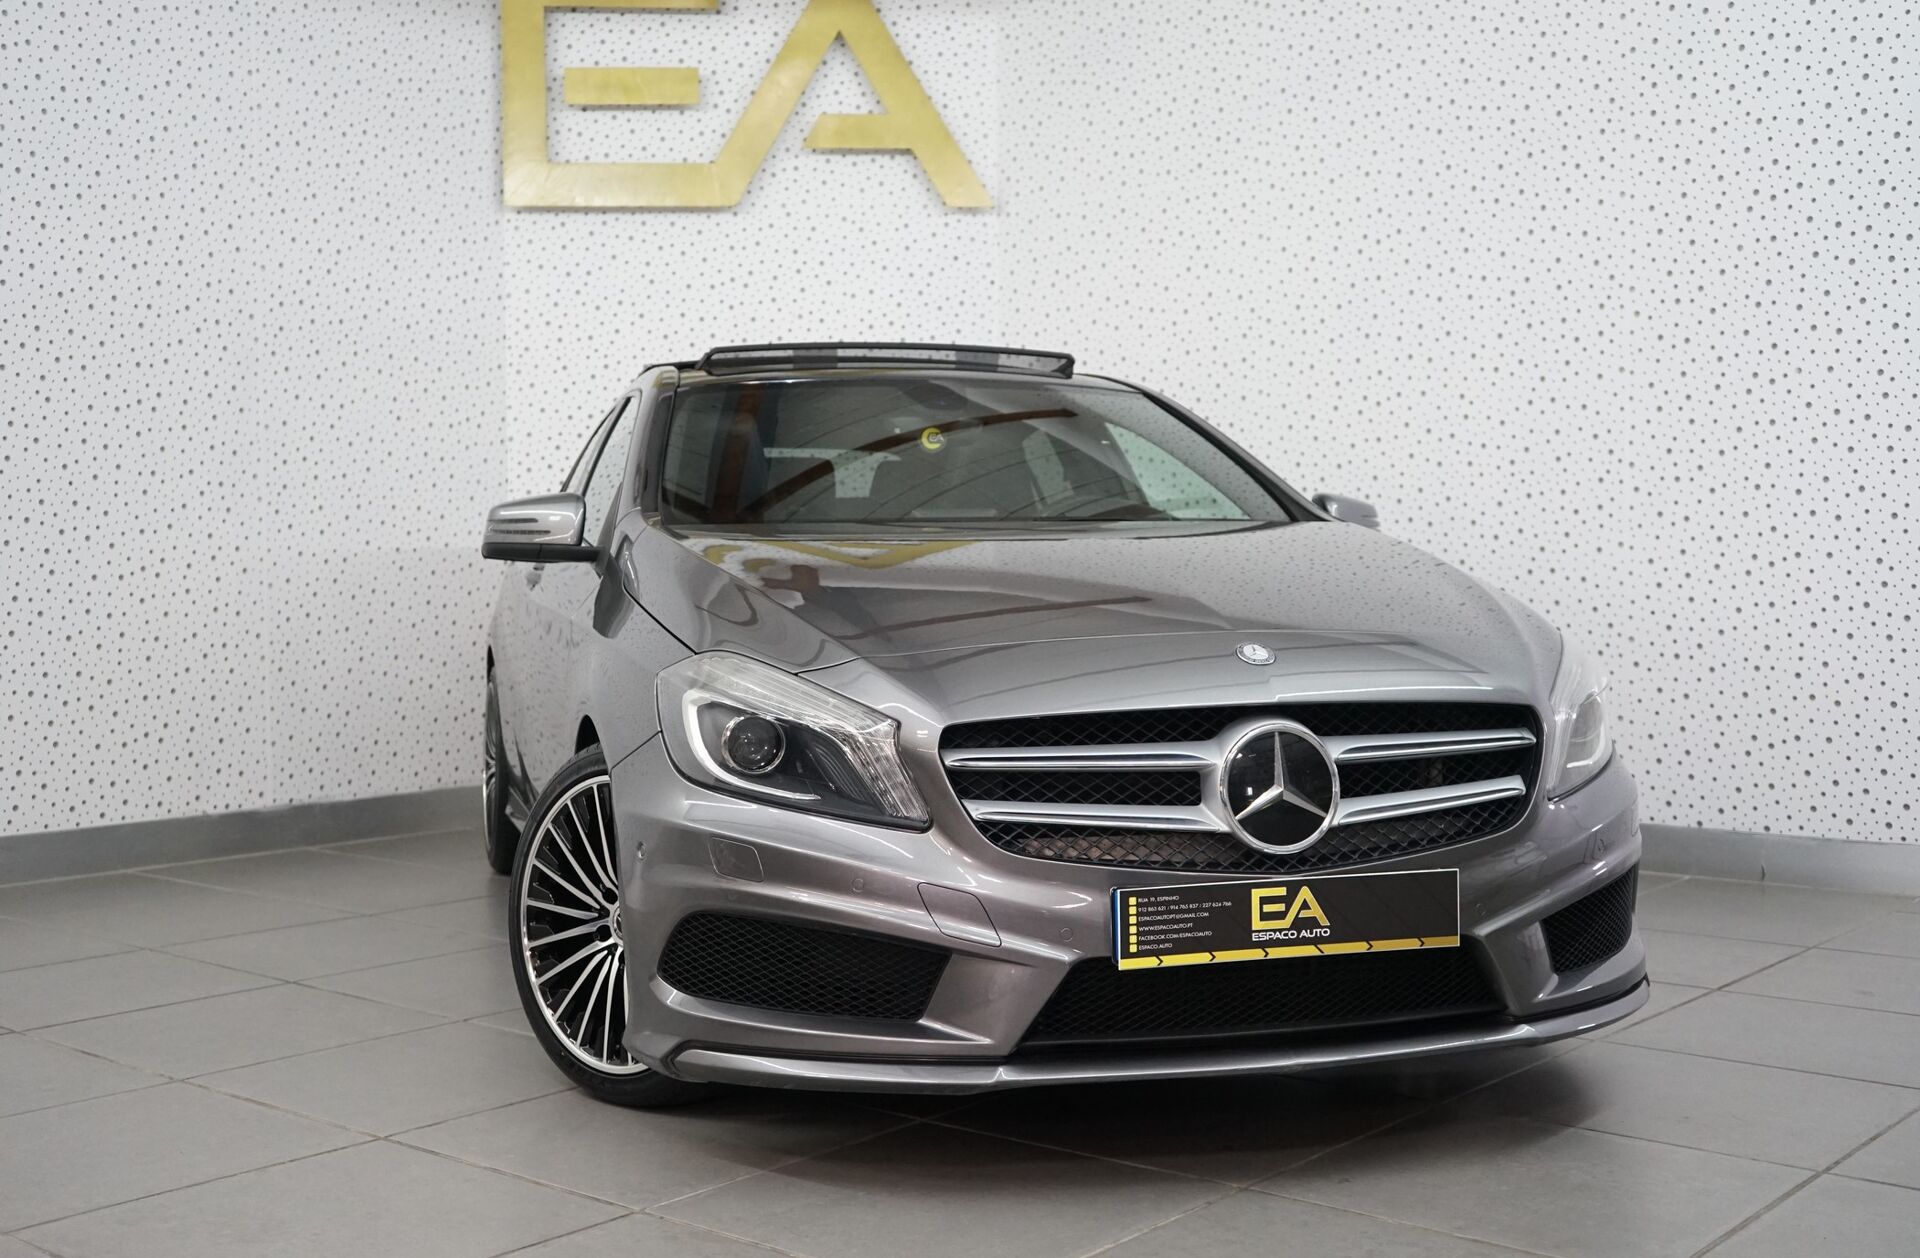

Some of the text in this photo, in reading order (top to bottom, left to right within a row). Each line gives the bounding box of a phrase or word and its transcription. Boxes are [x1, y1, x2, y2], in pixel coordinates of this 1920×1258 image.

[500, 0, 993, 207] EA
[1251, 886, 1331, 930] EA
[1252, 928, 1331, 941] ESPACO AUTO
